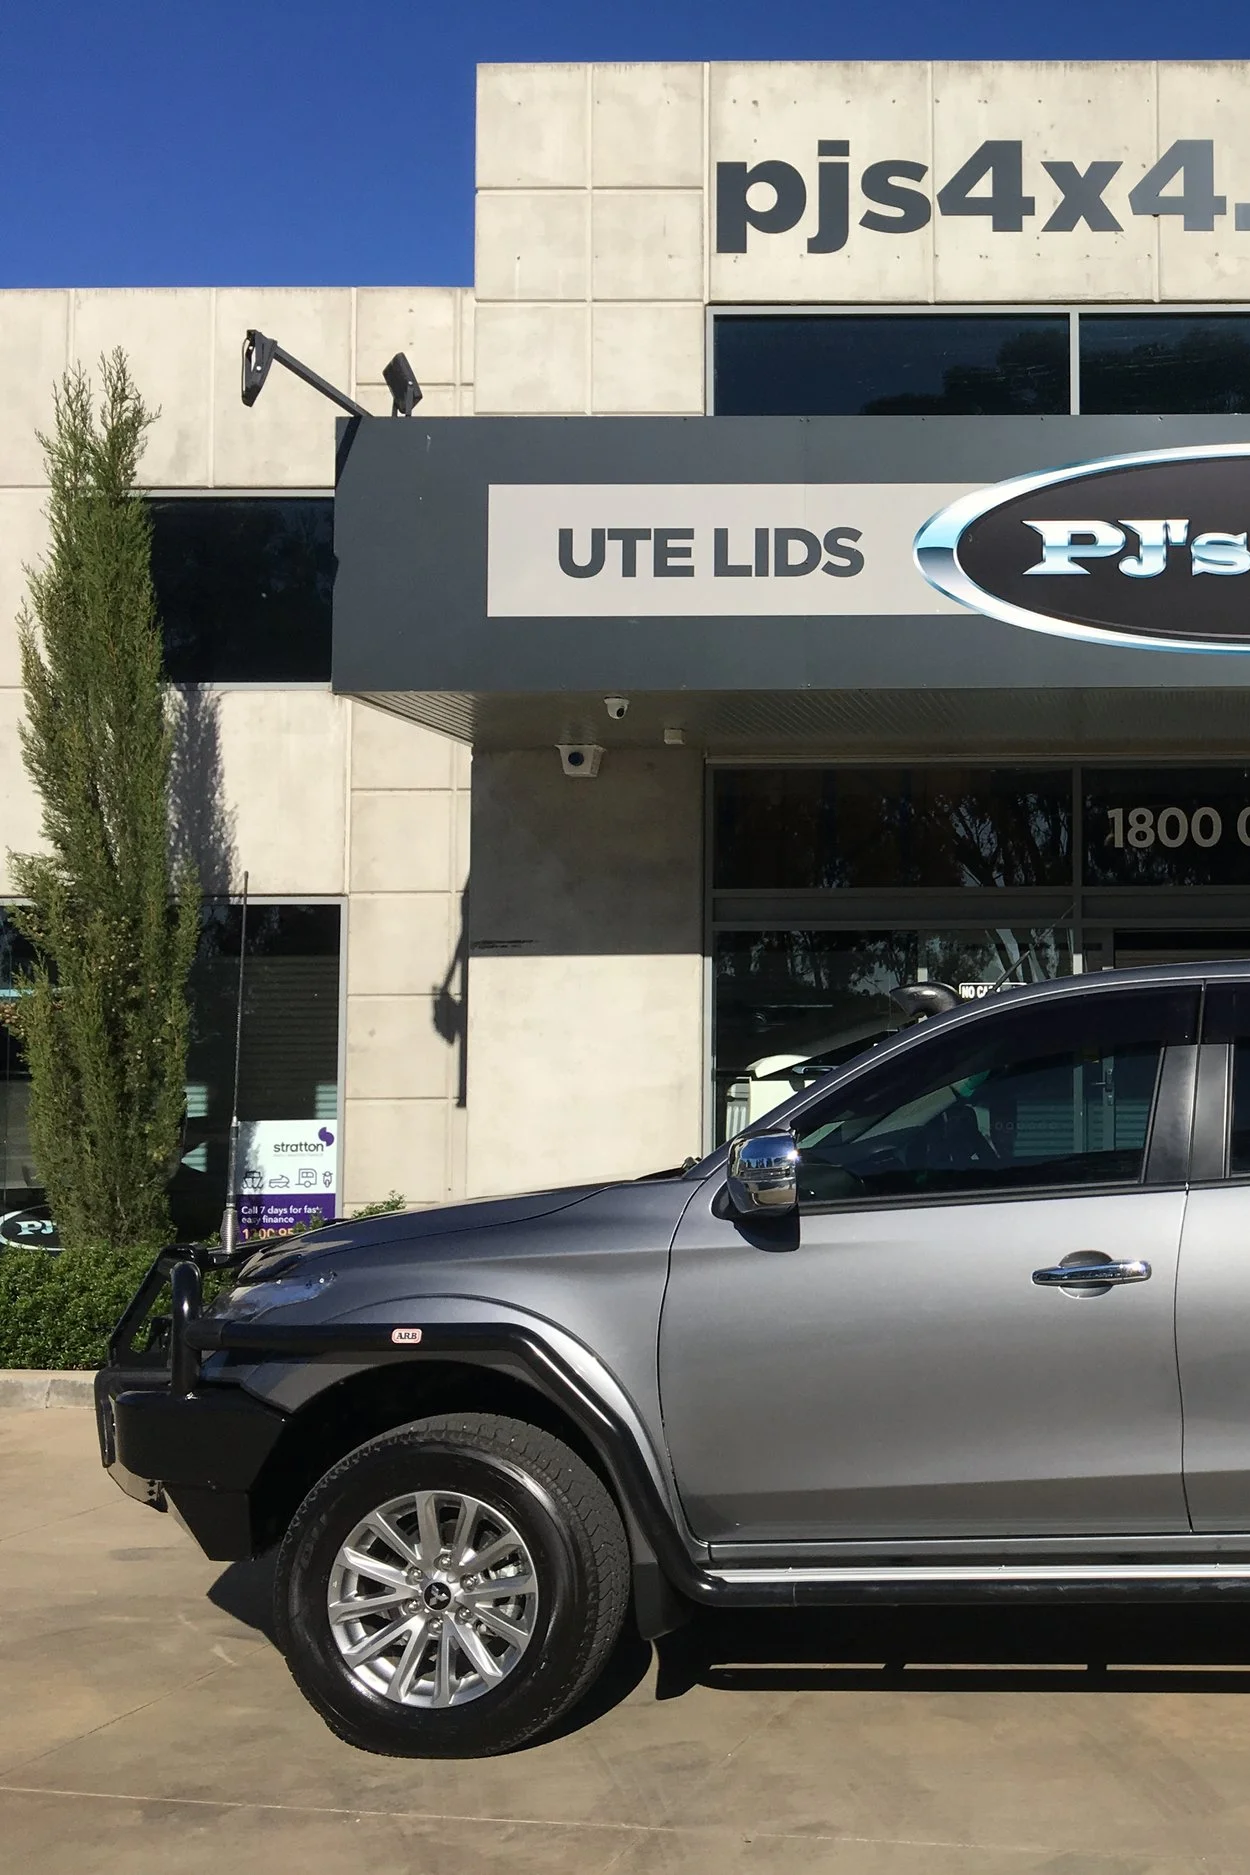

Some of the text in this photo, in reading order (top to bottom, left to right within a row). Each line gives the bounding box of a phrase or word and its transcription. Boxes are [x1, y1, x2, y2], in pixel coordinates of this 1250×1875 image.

[558, 526, 865, 579] UTE LIDS
[1107, 806, 1222, 849] 1800
[962, 986, 975, 998] NO
[273, 1142, 324, 1152] stratton
[241, 1206, 258, 1215] Call
[260, 1206, 266, 1214] 7
[267, 1205, 288, 1216] days
[289, 1205, 302, 1214] for
[262, 1215, 295, 1224] finance
[15, 1219, 55, 1236] PJ
[396, 1332, 418, 1340] ARB
